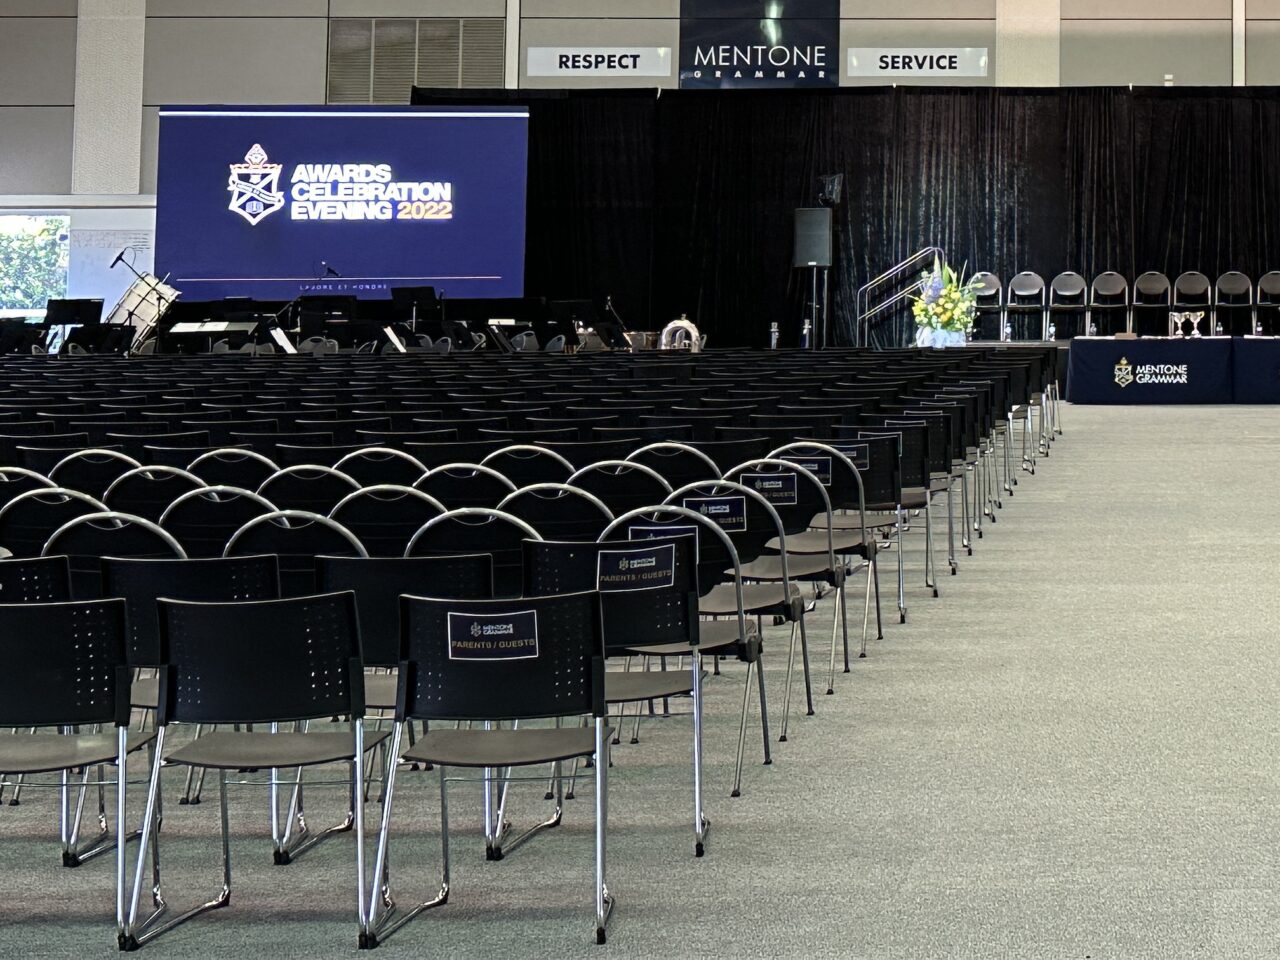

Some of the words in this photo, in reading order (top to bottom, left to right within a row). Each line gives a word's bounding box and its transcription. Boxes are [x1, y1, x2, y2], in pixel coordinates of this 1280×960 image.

[558, 54, 641, 70] RESPECT
[694, 45, 826, 66] MENTONE
[878, 54, 958, 70] SERVICE
[694, 70, 826, 79] GRAMMAR
[291, 164, 391, 183] AWARDS
[291, 182, 451, 201] CELEBRATION
[291, 201, 393, 220] EVENING
[396, 201, 453, 220] 2022
[1136, 364, 1188, 374] MENTONE
[1136, 373, 1188, 384] GRAMMAR
[451, 640, 491, 649] PARENTS
[498, 638, 535, 648] GUESTS
